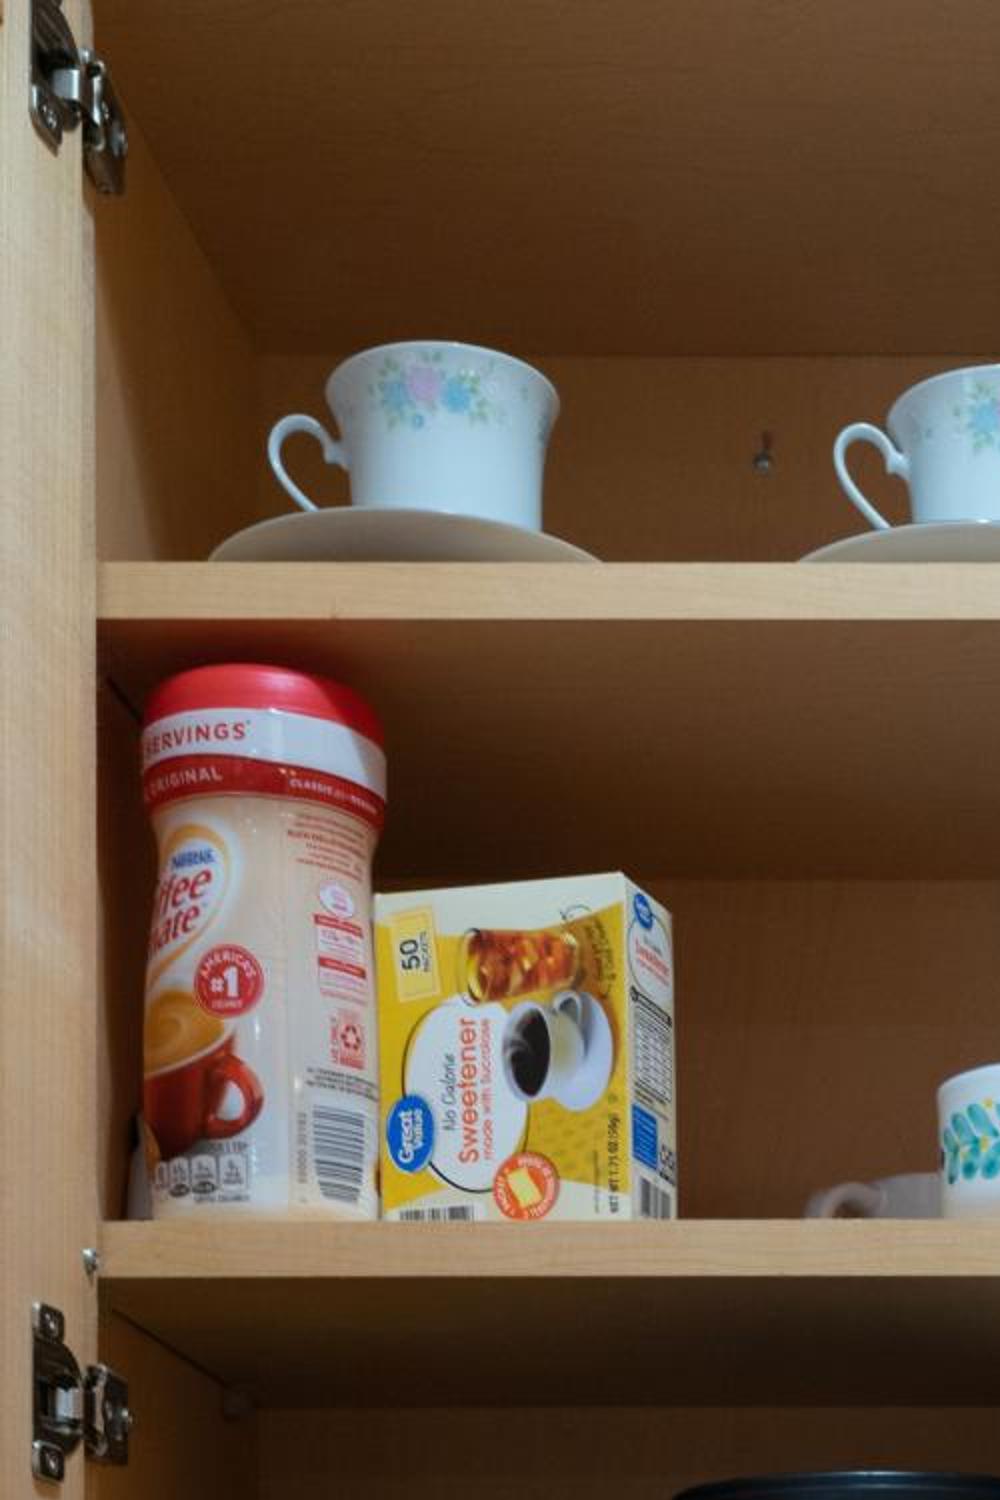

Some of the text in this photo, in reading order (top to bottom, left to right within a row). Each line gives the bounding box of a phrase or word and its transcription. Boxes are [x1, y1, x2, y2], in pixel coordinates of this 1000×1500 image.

[209, 964, 240, 998] #1
[398, 939, 421, 971] 50
[440, 1053, 456, 1131] No Calorie
[457, 1016, 480, 1165] Sweetener
[396, 1108, 425, 1164] Great Value
